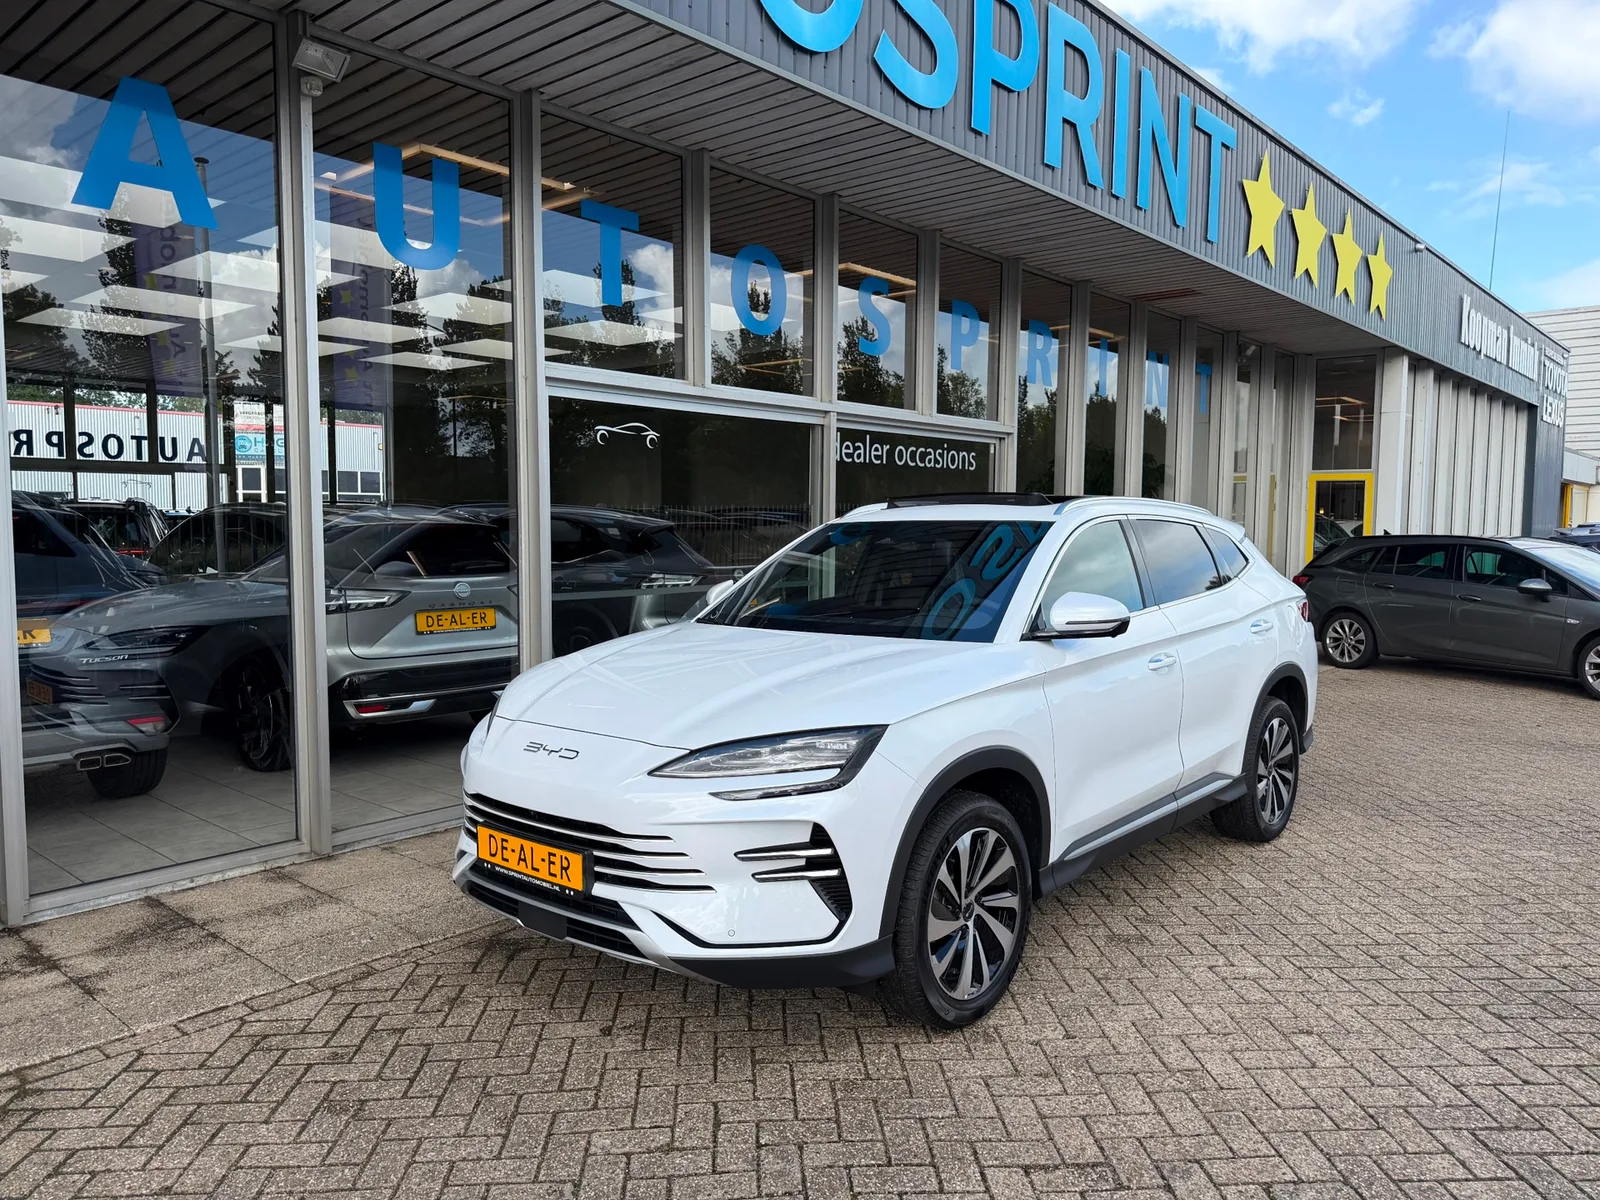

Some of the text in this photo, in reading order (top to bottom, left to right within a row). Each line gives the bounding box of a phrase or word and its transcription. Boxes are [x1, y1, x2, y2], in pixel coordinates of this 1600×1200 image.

[1461, 294, 1508, 366] Koopman
[1544, 360, 1568, 397] TOYOTA
[1542, 394, 1564, 428] LEXUS
[895, 443, 976, 471] occasions
[426, 611, 487, 628] DE-AL-ER
[429, 600, 492, 608] QASHQAI
[523, 741, 580, 760] BYD
[488, 833, 572, 883] DE-AL-ER
